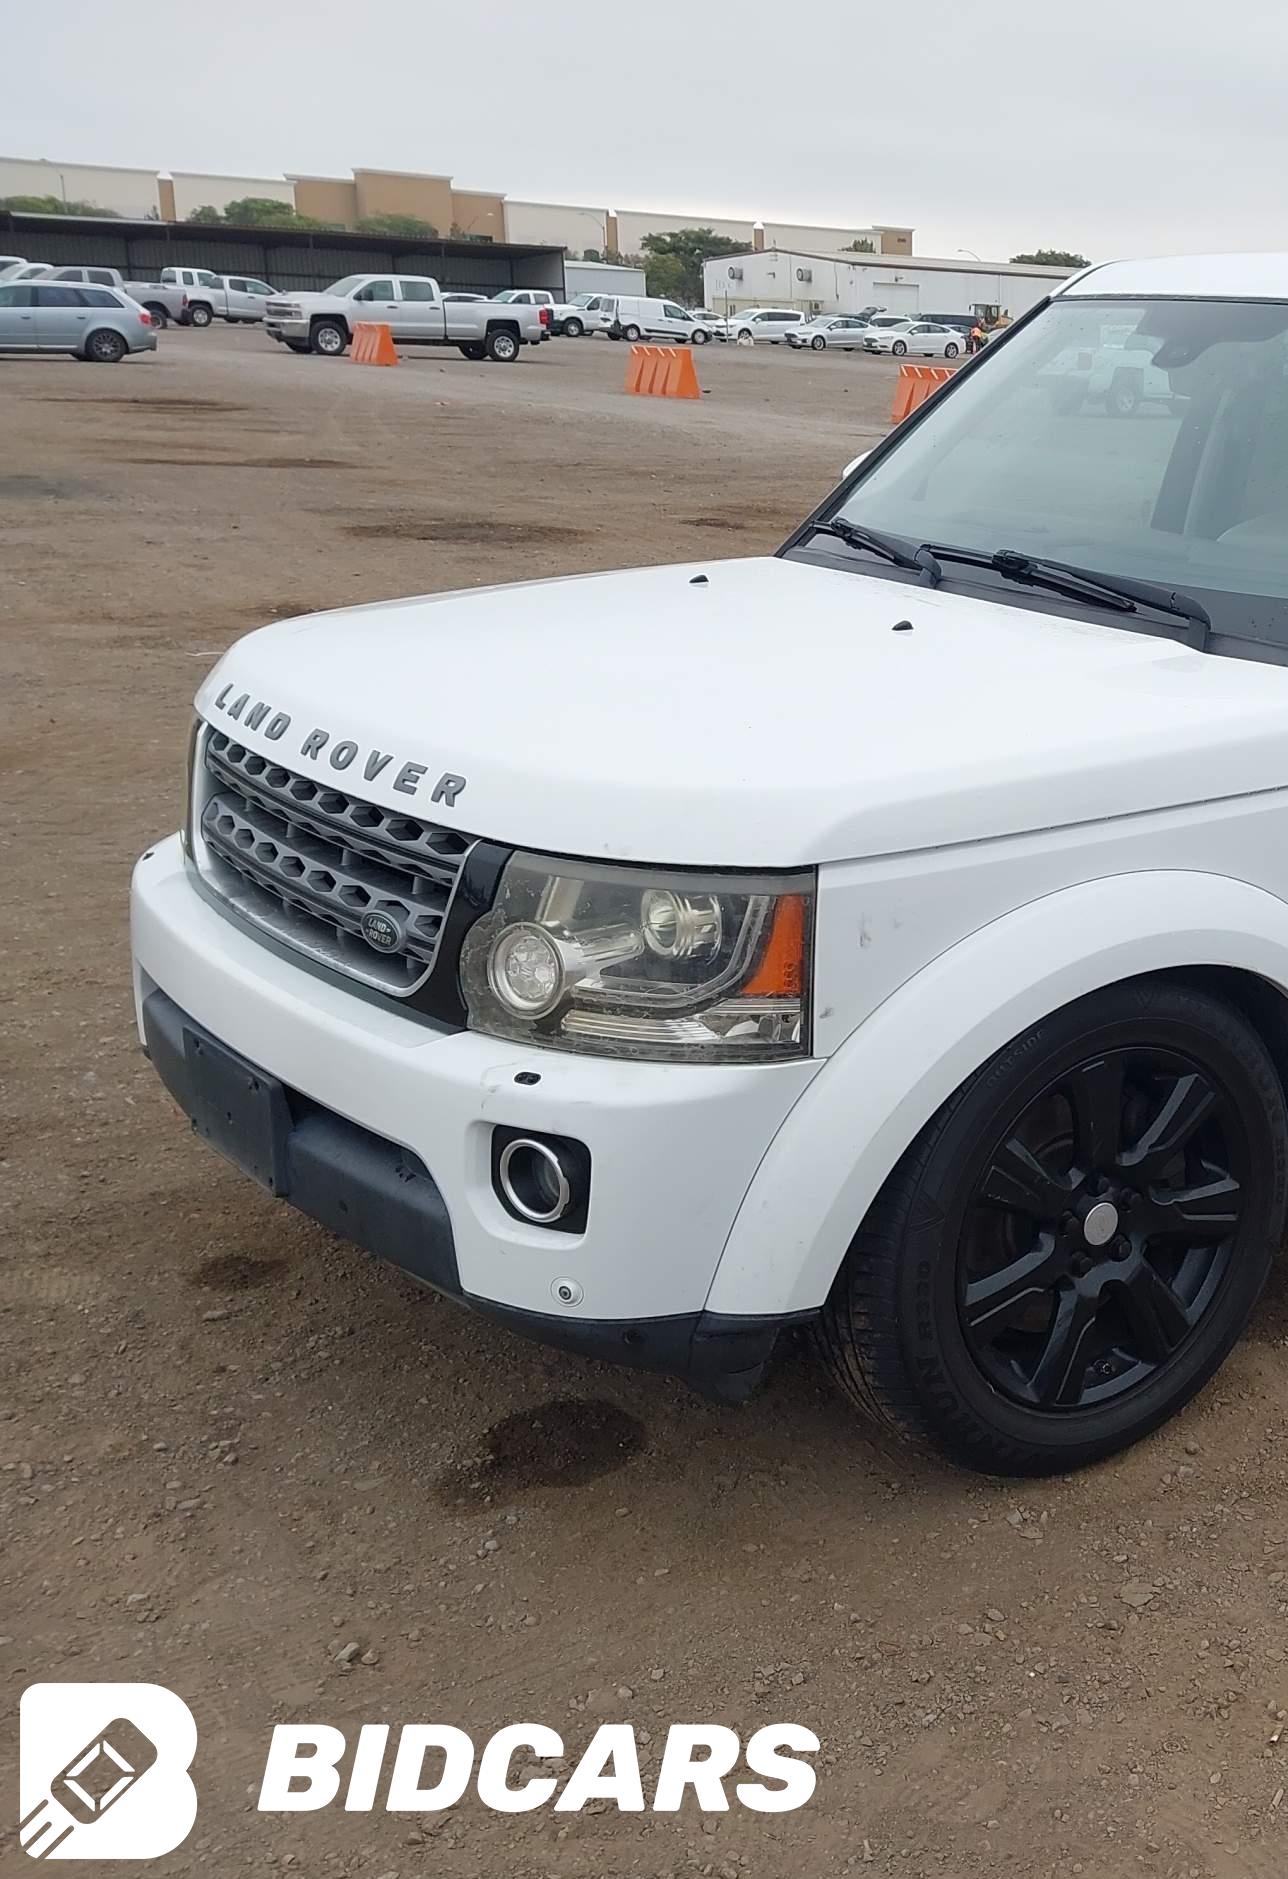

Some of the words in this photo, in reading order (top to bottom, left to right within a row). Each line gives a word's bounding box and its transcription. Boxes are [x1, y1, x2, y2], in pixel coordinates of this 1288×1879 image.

[214, 682, 292, 741] LAND
[299, 728, 467, 808] ROVER
[368, 917, 387, 933] LAND
[369, 928, 392, 945] ROVER
